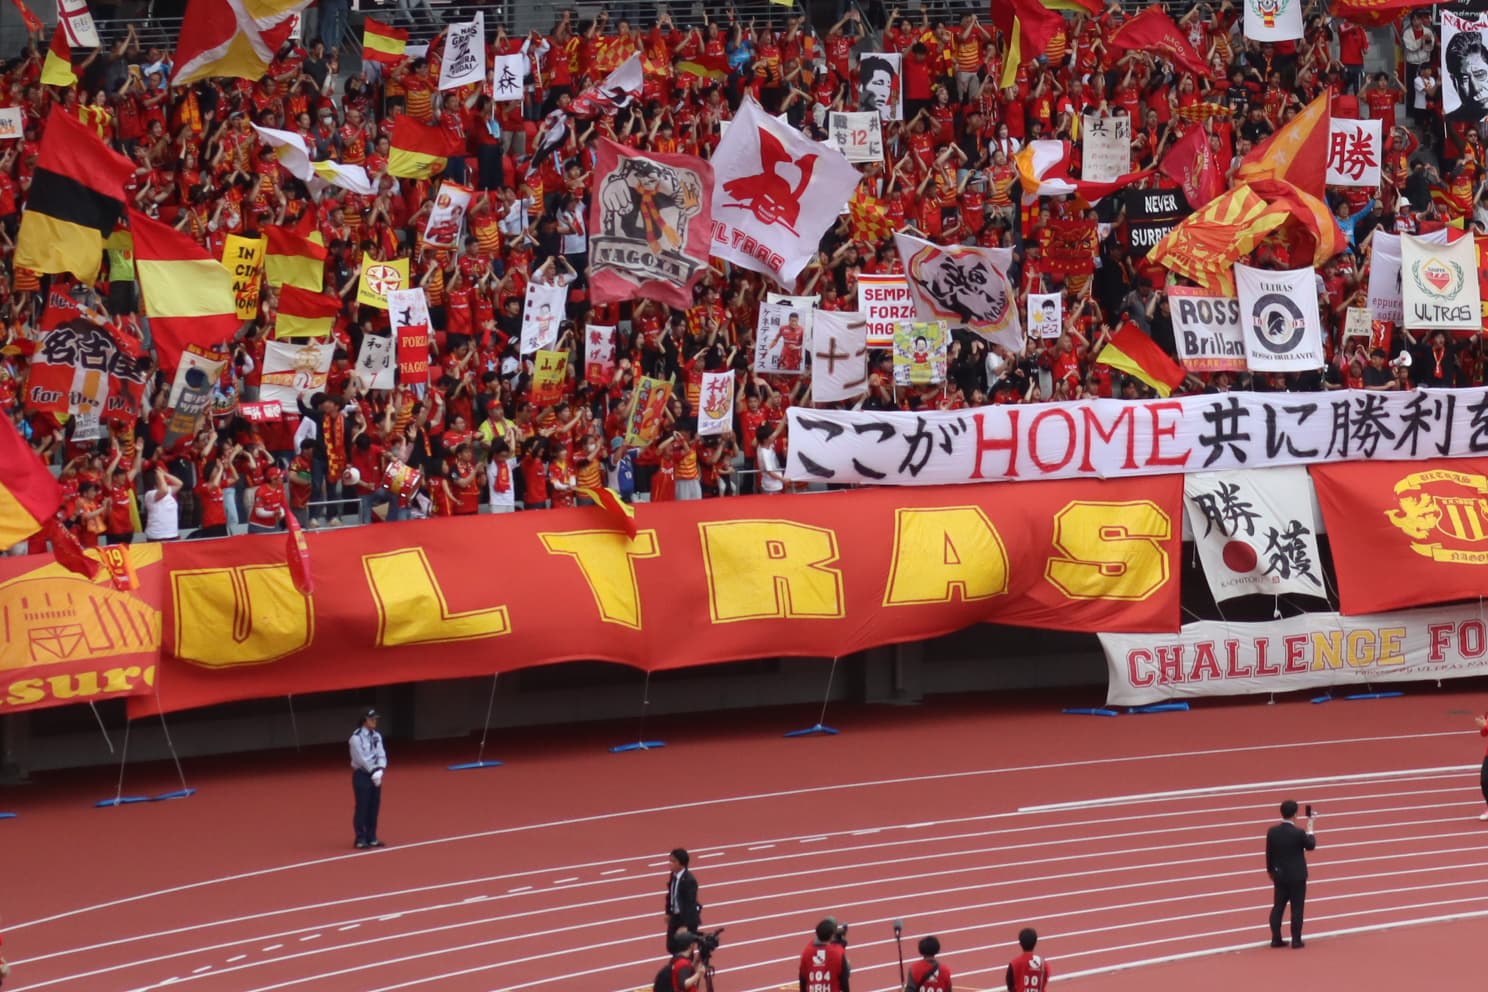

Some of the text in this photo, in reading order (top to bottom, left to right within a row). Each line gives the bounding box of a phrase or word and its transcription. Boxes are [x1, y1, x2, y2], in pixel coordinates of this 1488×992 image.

[850, 129, 868, 146] 12
[1326, 125, 1379, 181] 勝
[1144, 194, 1178, 213] NEVER
[238, 246, 255, 260] IN
[596, 244, 682, 279] NAGOYA
[870, 305, 917, 319] FORZA
[1179, 298, 1241, 326] ROSS
[1413, 303, 1472, 322] ULTRAS
[31, 386, 64, 404] for
[171, 498, 1171, 669] ULTRAS
[1127, 625, 1406, 689] CHALLENGE
